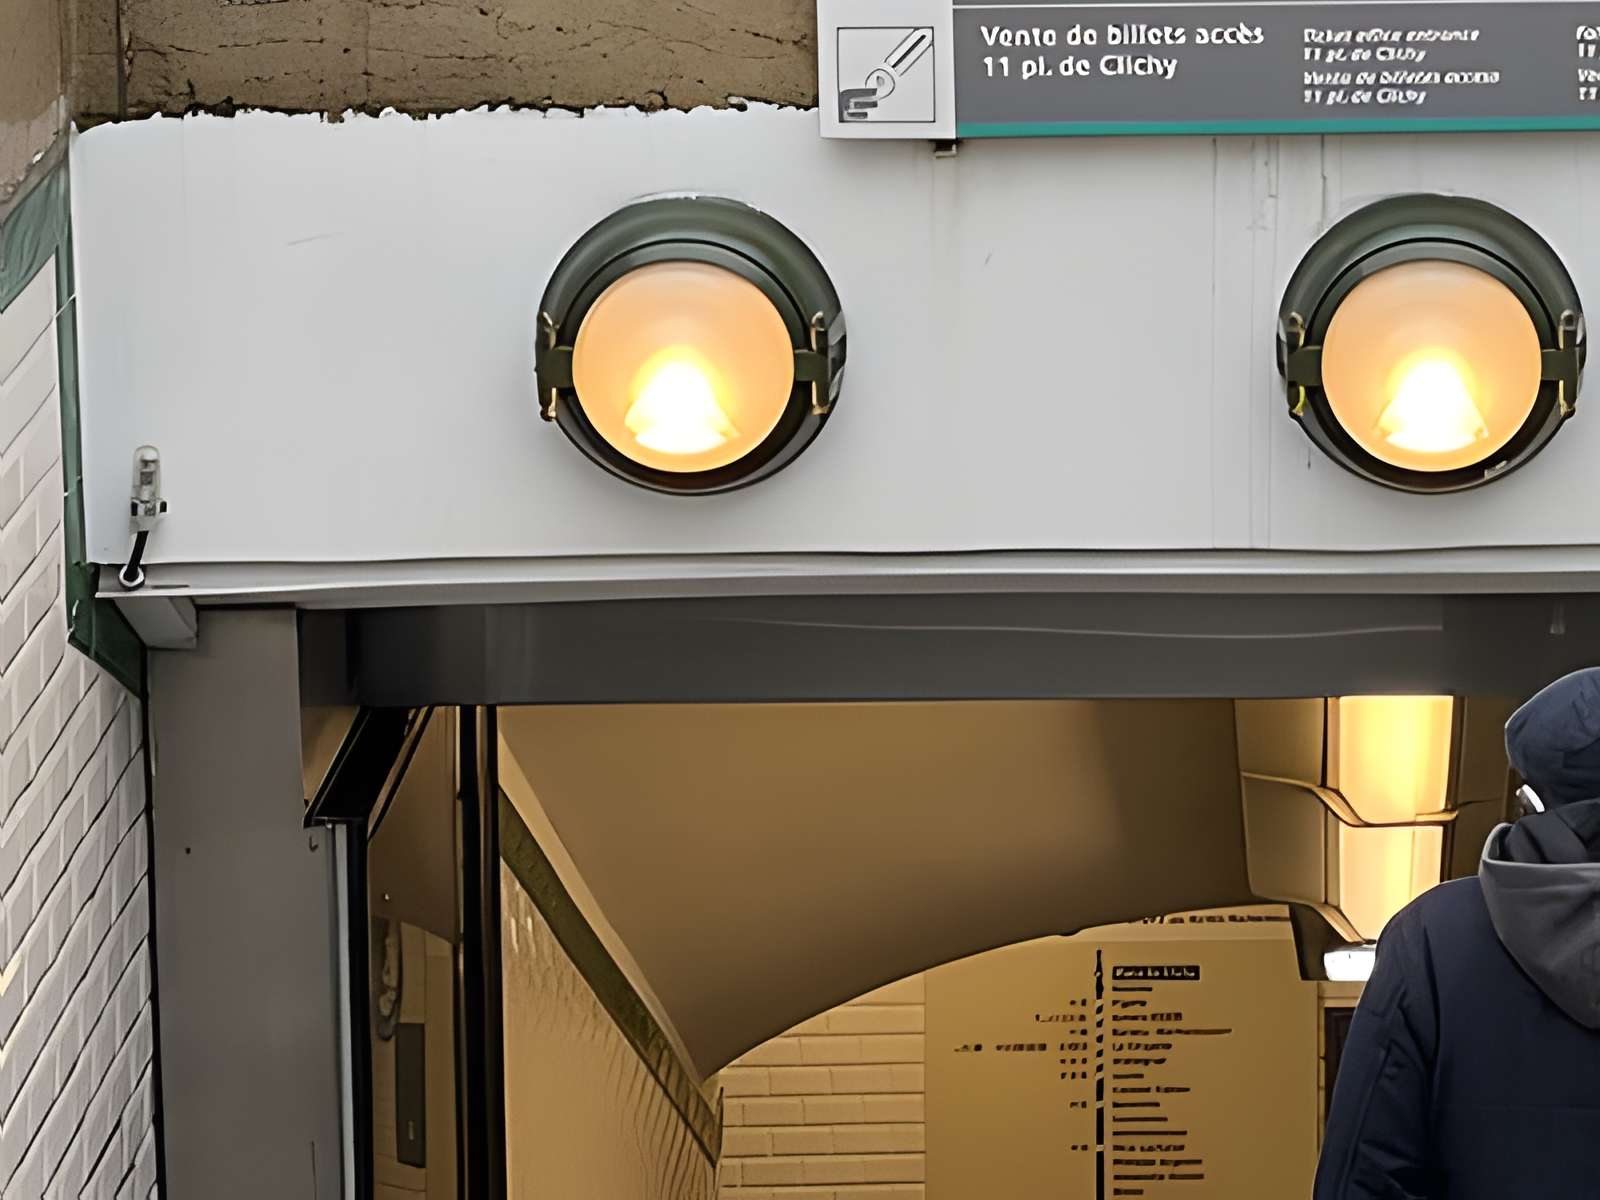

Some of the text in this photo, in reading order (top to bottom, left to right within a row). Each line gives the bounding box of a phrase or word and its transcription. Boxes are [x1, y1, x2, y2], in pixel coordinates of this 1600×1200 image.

[980, 21, 1265, 47] Vente de billets accès
[983, 54, 1178, 81] 11 pl. de Clichy
